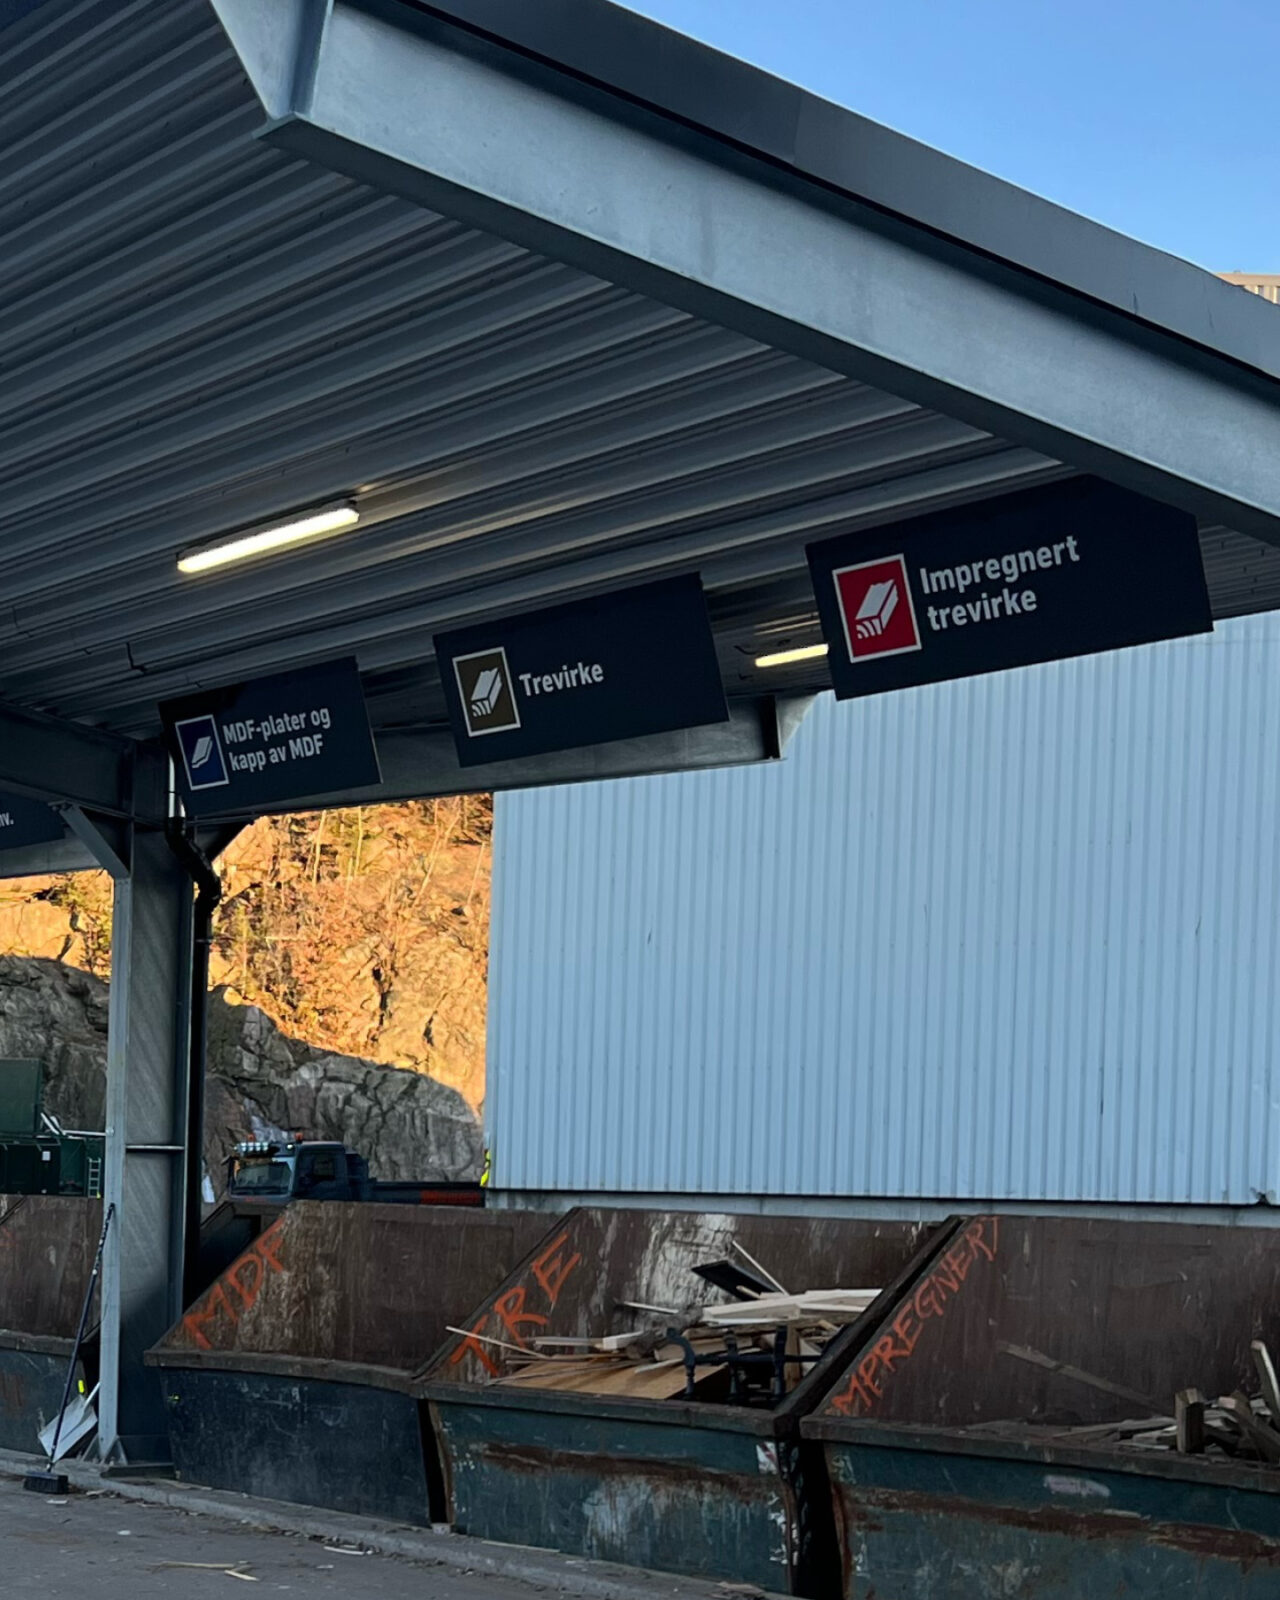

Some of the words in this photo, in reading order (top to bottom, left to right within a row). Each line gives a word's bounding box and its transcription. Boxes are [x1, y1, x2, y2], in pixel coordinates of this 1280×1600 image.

[919, 535, 1081, 594] Impregnert
[926, 587, 1038, 632] trevirke
[518, 661, 605, 697] Trevirke
[222, 712, 307, 745] MDF-plater
[310, 707, 332, 730] og
[228, 751, 267, 773] kapp
[268, 745, 287, 764] av
[288, 733, 324, 760] MDF
[183, 1214, 285, 1350] MDF
[449, 1231, 582, 1378] TRE
[830, 1215, 999, 1415] MPREGNERT
